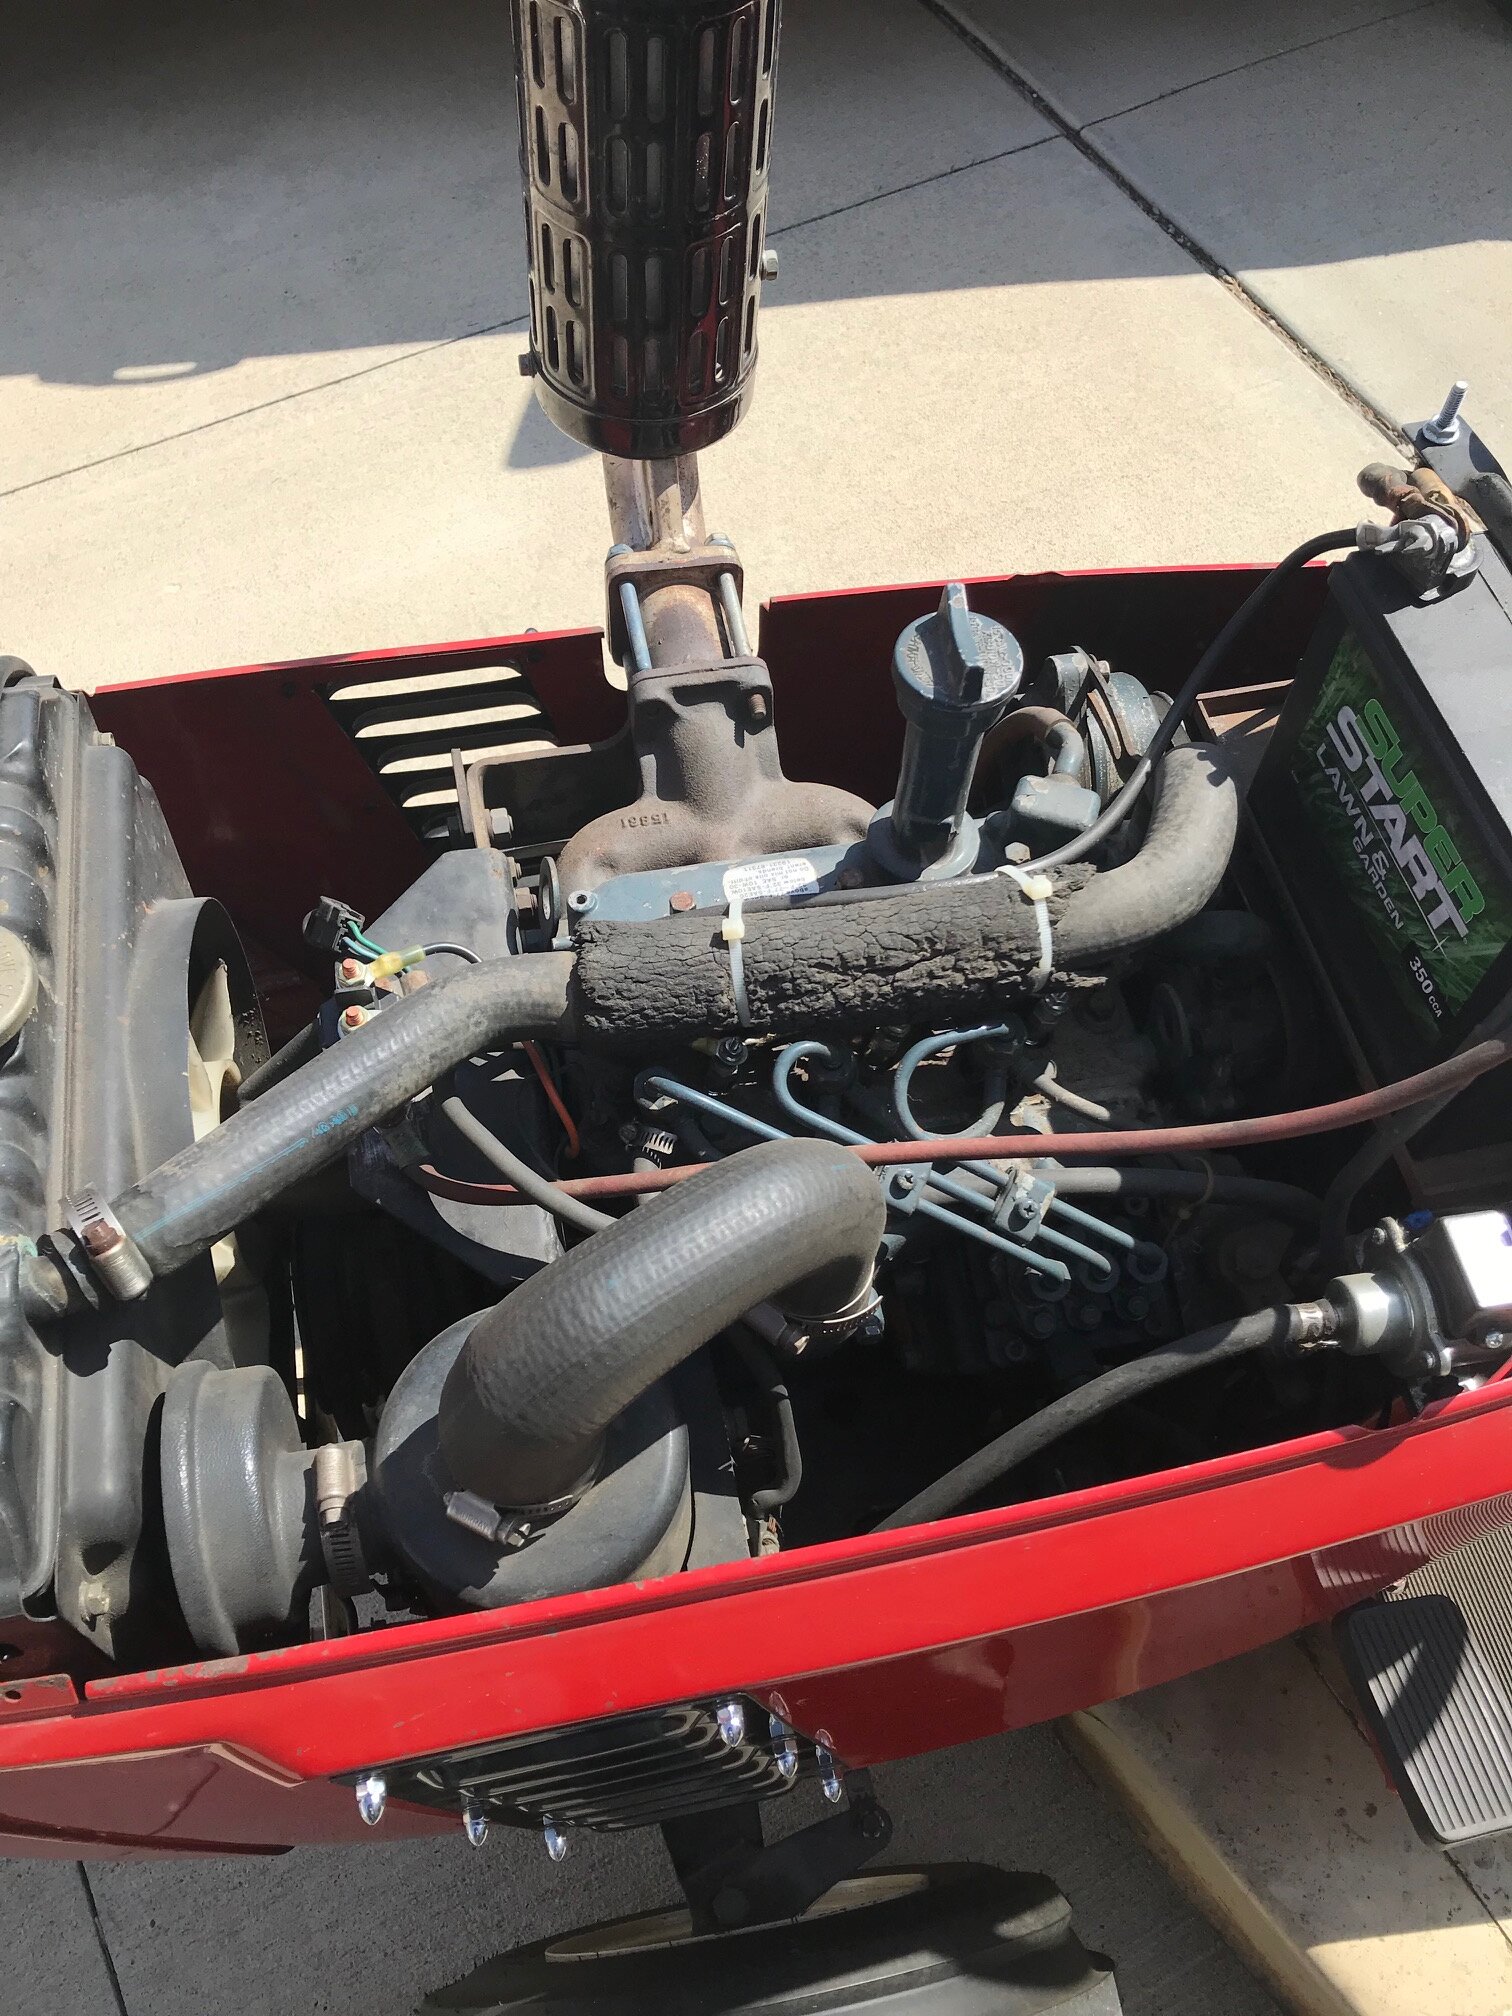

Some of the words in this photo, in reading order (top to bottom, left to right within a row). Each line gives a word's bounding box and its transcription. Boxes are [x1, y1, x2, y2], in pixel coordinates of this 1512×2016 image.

[1317, 743, 1374, 847] LAWN
[1371, 850, 1390, 881] &
[1326, 705, 1468, 938] START
[1355, 698, 1485, 924] SUPER
[1352, 836, 1404, 930] GARDEN
[1409, 956, 1434, 994] 350
[1428, 996, 1443, 1018] CCA
